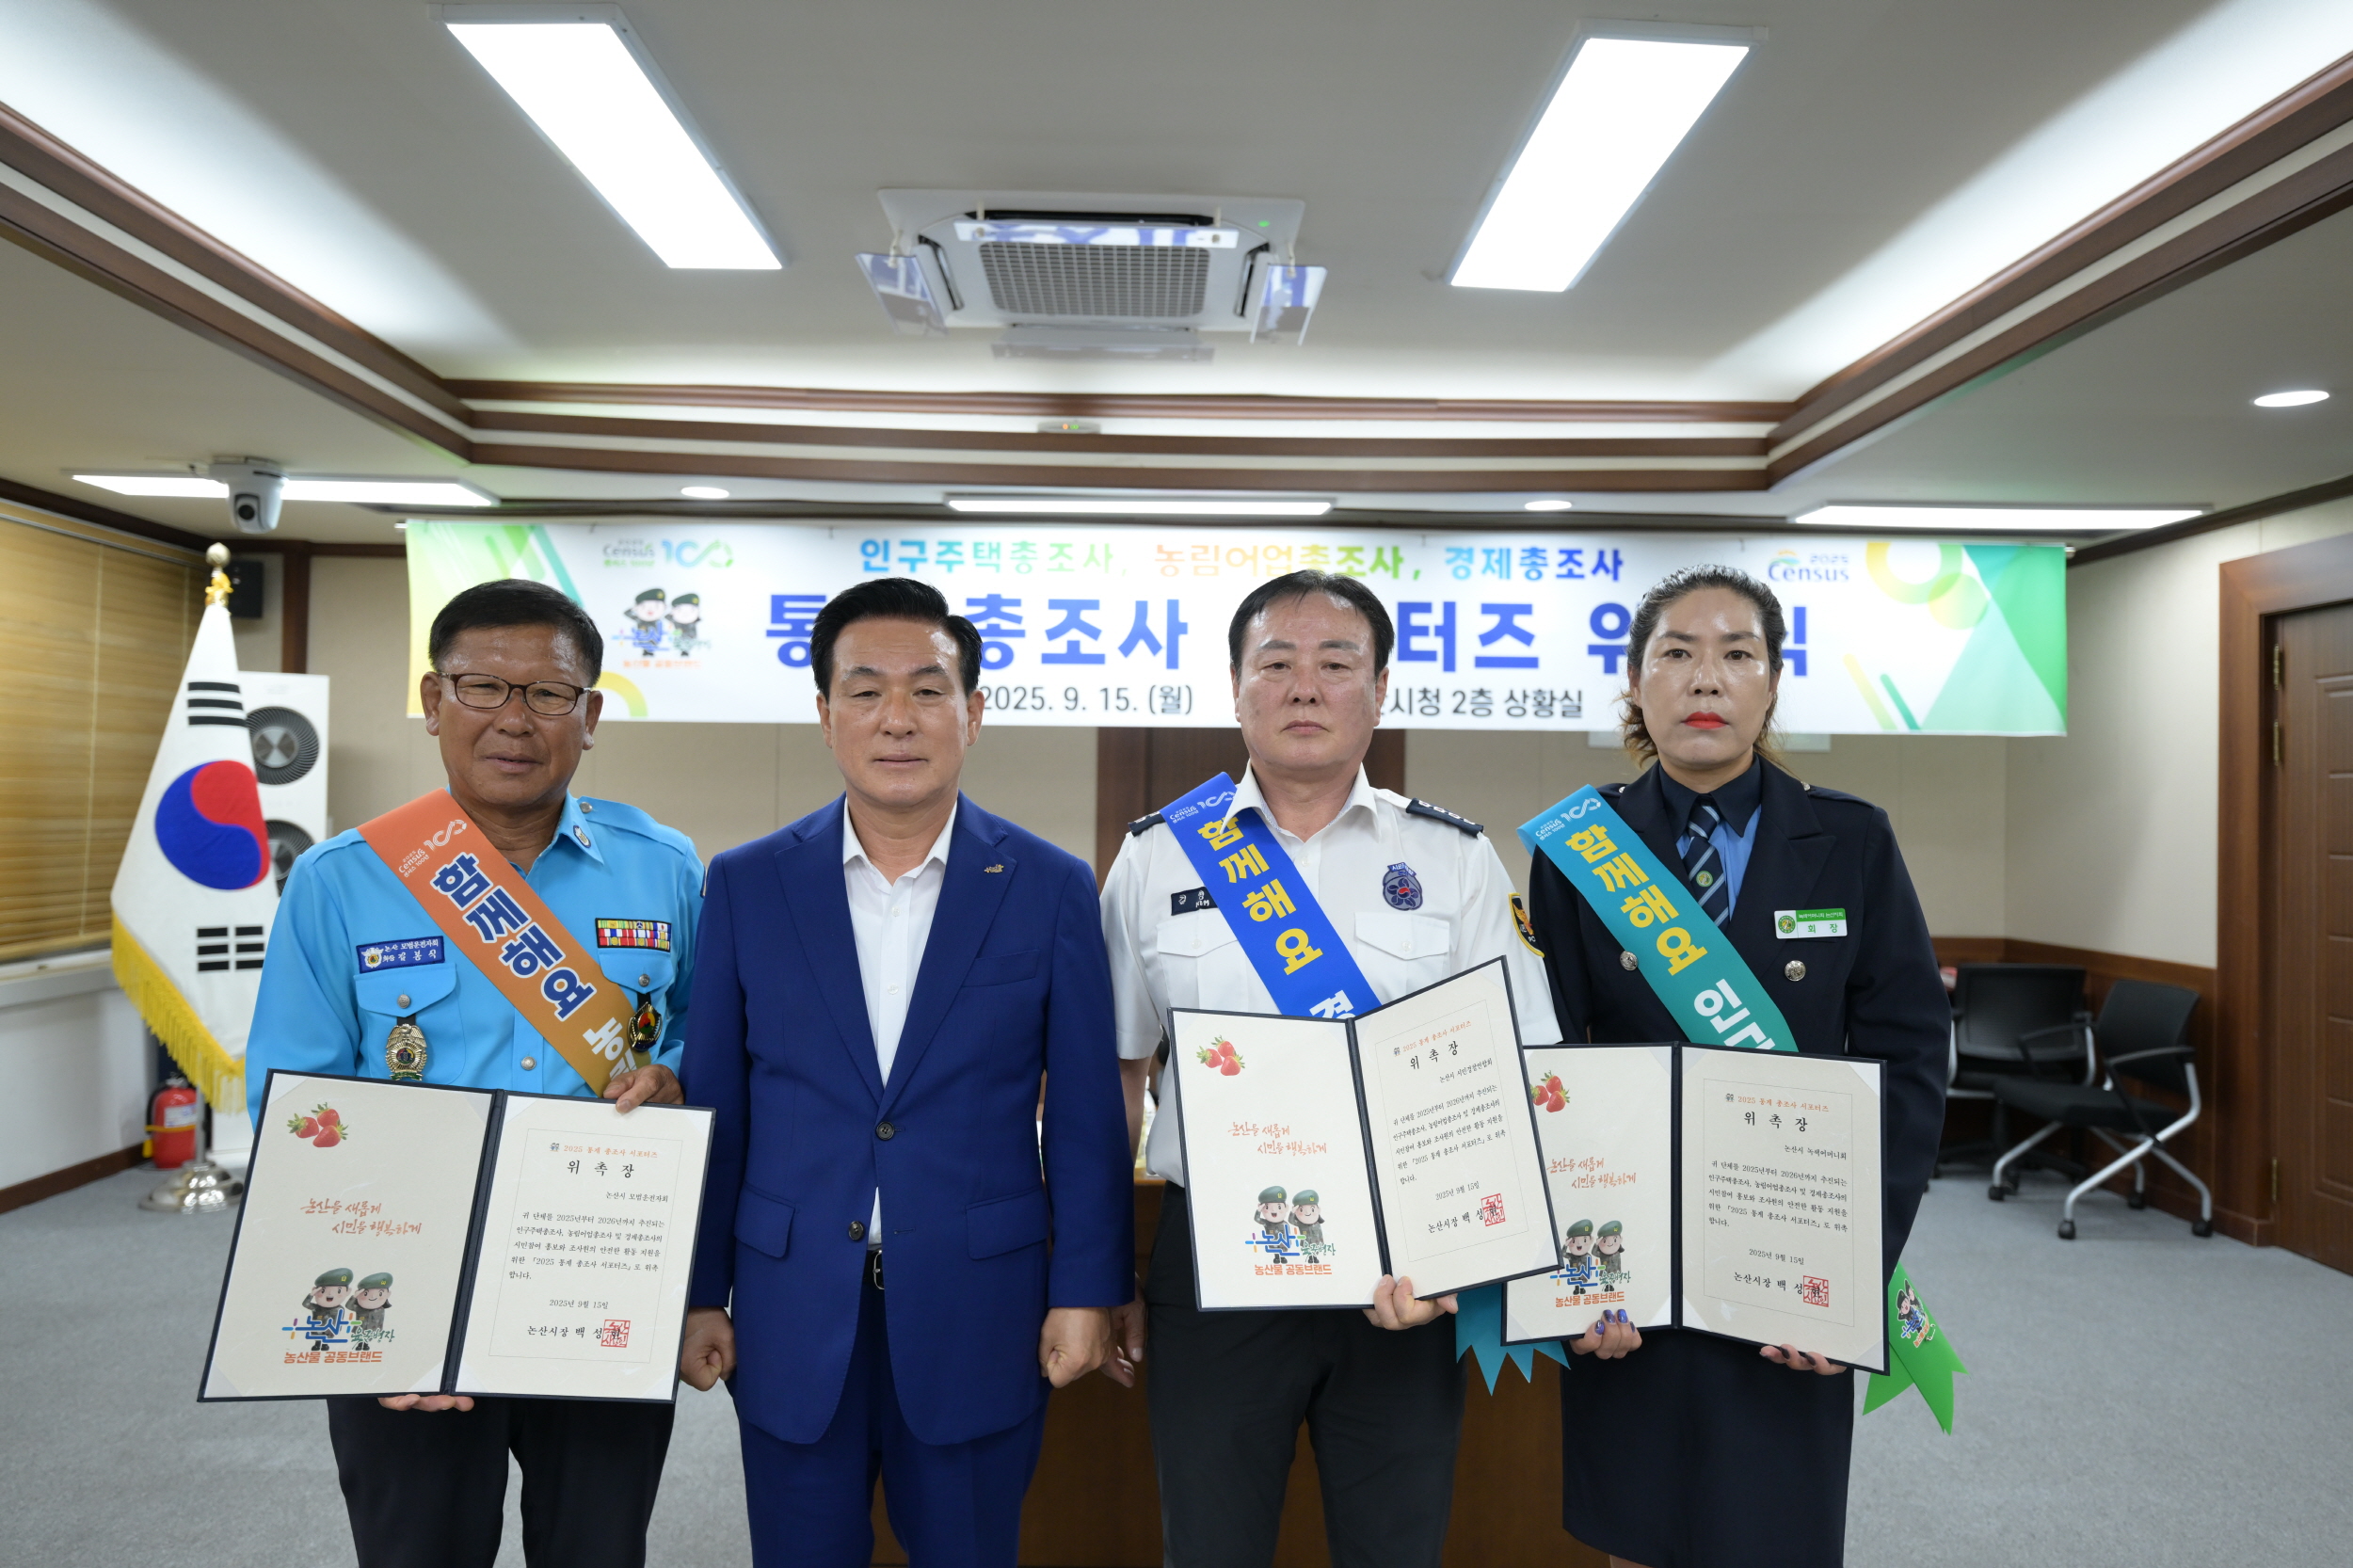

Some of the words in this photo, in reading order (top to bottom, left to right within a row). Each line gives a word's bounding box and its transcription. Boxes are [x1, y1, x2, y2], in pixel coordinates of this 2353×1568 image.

[860, 537, 1128, 577] 인구주택총조사,
[1445, 545, 1624, 582] 경제총조사
[1768, 560, 1849, 583] Census
[963, 593, 1189, 671] 총조사
[1147, 684, 1193, 715] (월)
[1451, 687, 1494, 717] 2층
[1504, 688, 1584, 719] 상황실
[1535, 818, 1562, 837] Census
[398, 848, 425, 873] Census
[1196, 816, 1323, 976] 함께해요
[1565, 824, 1708, 976] 함께해요
[384, 944, 399, 952] 논산
[400, 938, 439, 950] 모범운전자회
[431, 852, 597, 1021] 함께해요
[563, 1144, 584, 1153] 2025
[586, 1146, 601, 1155] 통계
[604, 1147, 627, 1157] 총조사
[629, 1149, 658, 1159] 서포터즈
[605, 1191, 626, 1201] 논산시
[533, 1211, 553, 1222] 단체를
[638, 1219, 664, 1228] 추진되는
[513, 1240, 542, 1251] 시민참여
[544, 1242, 566, 1252] 홍보와
[568, 1244, 597, 1254] 조사원의
[600, 1245, 620, 1256] 안전한
[640, 1248, 661, 1257] 지원을
[558, 1258, 572, 1268] 통계
[576, 1259, 598, 1269] 총조사
[1255, 1264, 1284, 1276] 농산물
[1285, 1264, 1333, 1276] 공동브랜드
[508, 1271, 532, 1280] 합니다.
[549, 1299, 575, 1308] 2025년
[577, 1300, 589, 1309] 9월
[593, 1301, 609, 1310] 15일
[1555, 1295, 1581, 1308] 농산물
[1583, 1290, 1625, 1306] 공동브랜드
[527, 1325, 569, 1337] 논산시장
[284, 1352, 320, 1365] 농산물
[324, 1351, 382, 1364] 공동브랜드
